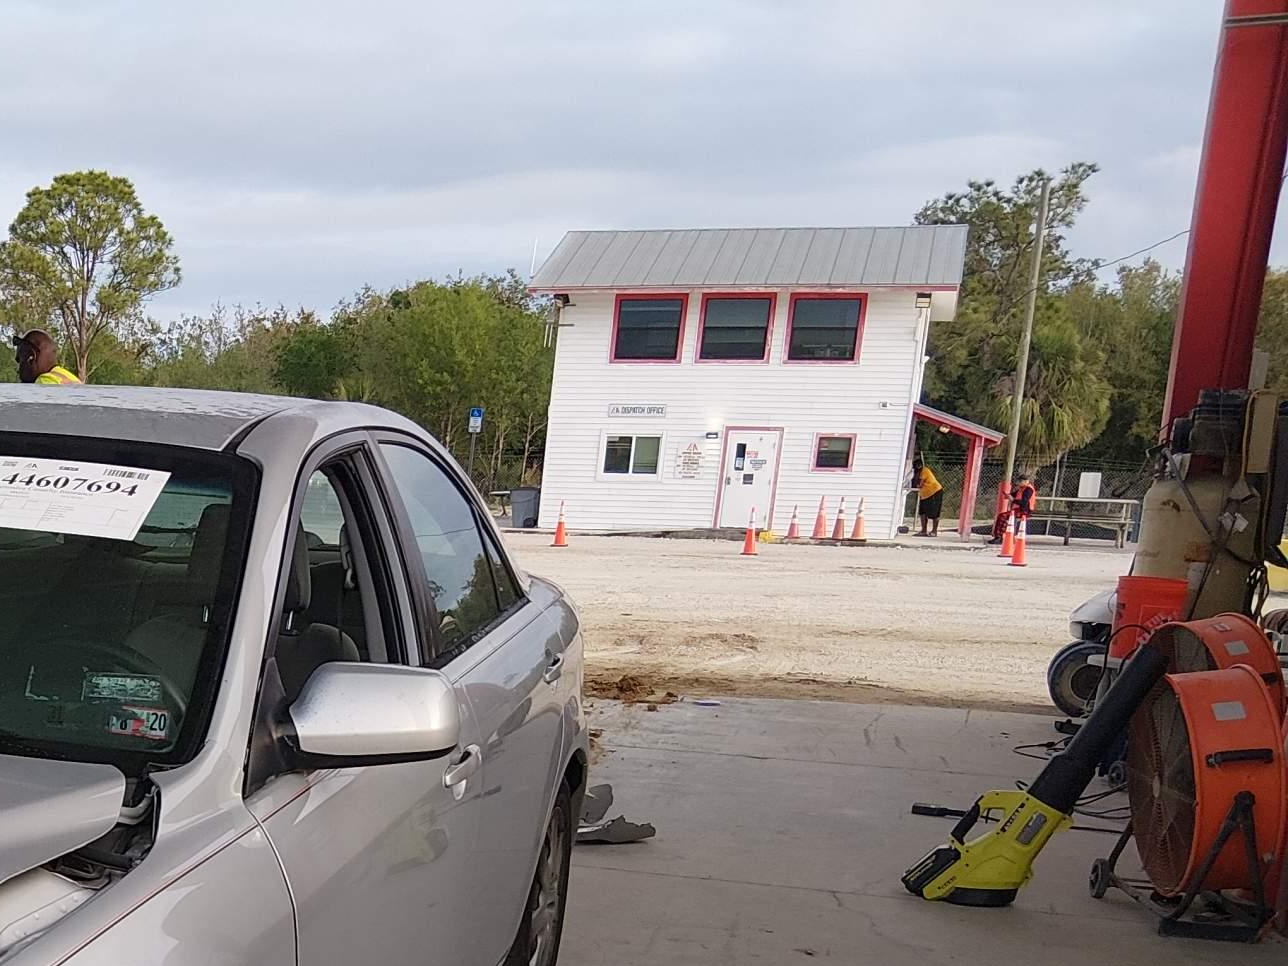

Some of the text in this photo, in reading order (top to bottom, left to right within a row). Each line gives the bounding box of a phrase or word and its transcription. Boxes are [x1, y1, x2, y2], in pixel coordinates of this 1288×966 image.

[646, 406, 665, 415] OFFICE
[1, 472, 139, 497] 44607694
[150, 712, 167, 732] 20
